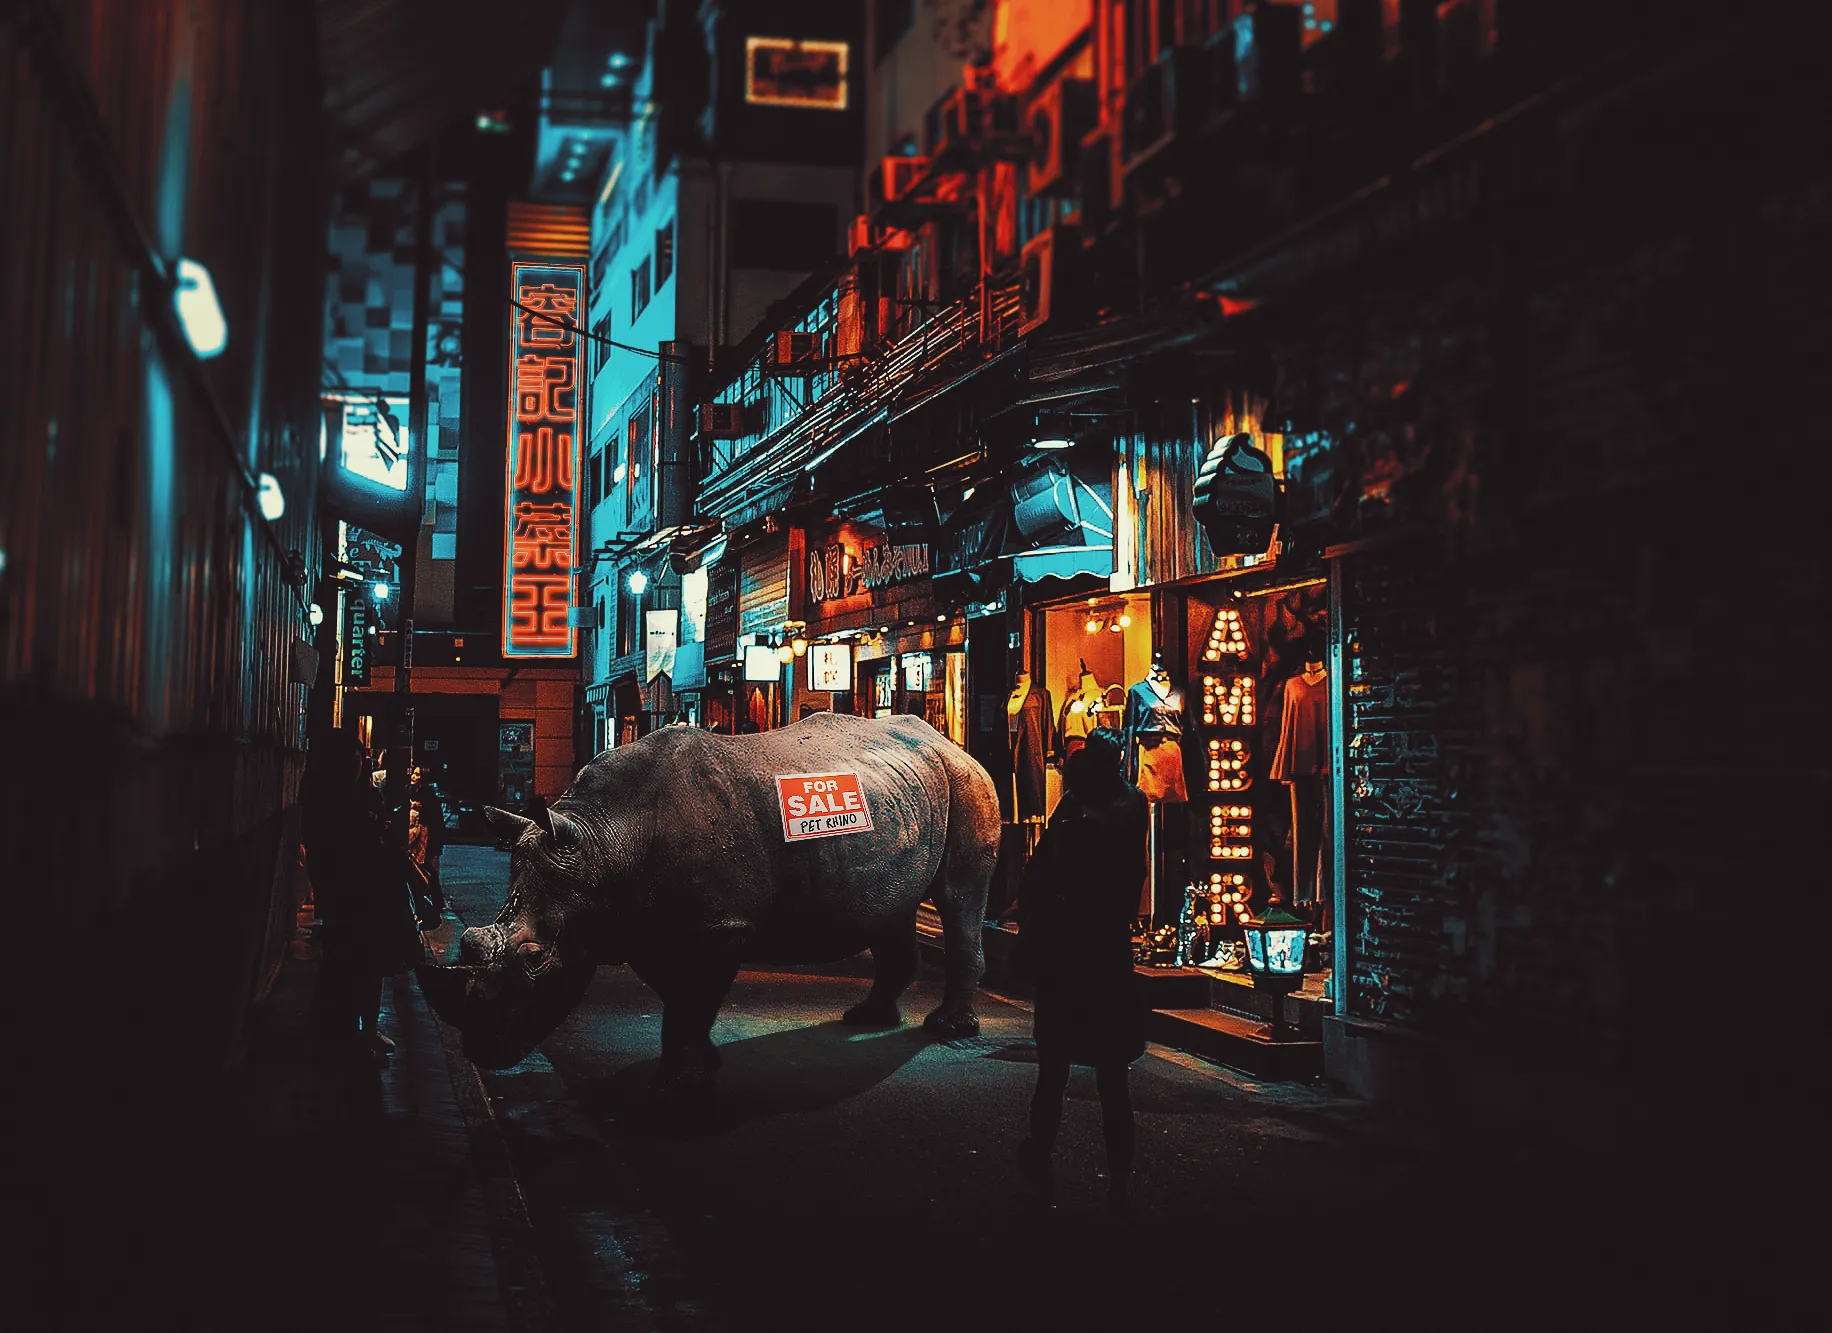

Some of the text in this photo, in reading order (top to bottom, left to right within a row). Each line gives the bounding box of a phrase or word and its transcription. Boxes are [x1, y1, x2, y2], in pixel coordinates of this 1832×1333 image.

[511, 283, 577, 646] 容記小菜王
[349, 599, 367, 679] quarter
[803, 779, 839, 794] FOR
[1201, 609, 1257, 926] AMBER
[787, 790, 862, 817] SALE
[800, 813, 857, 834] PET RHINO
